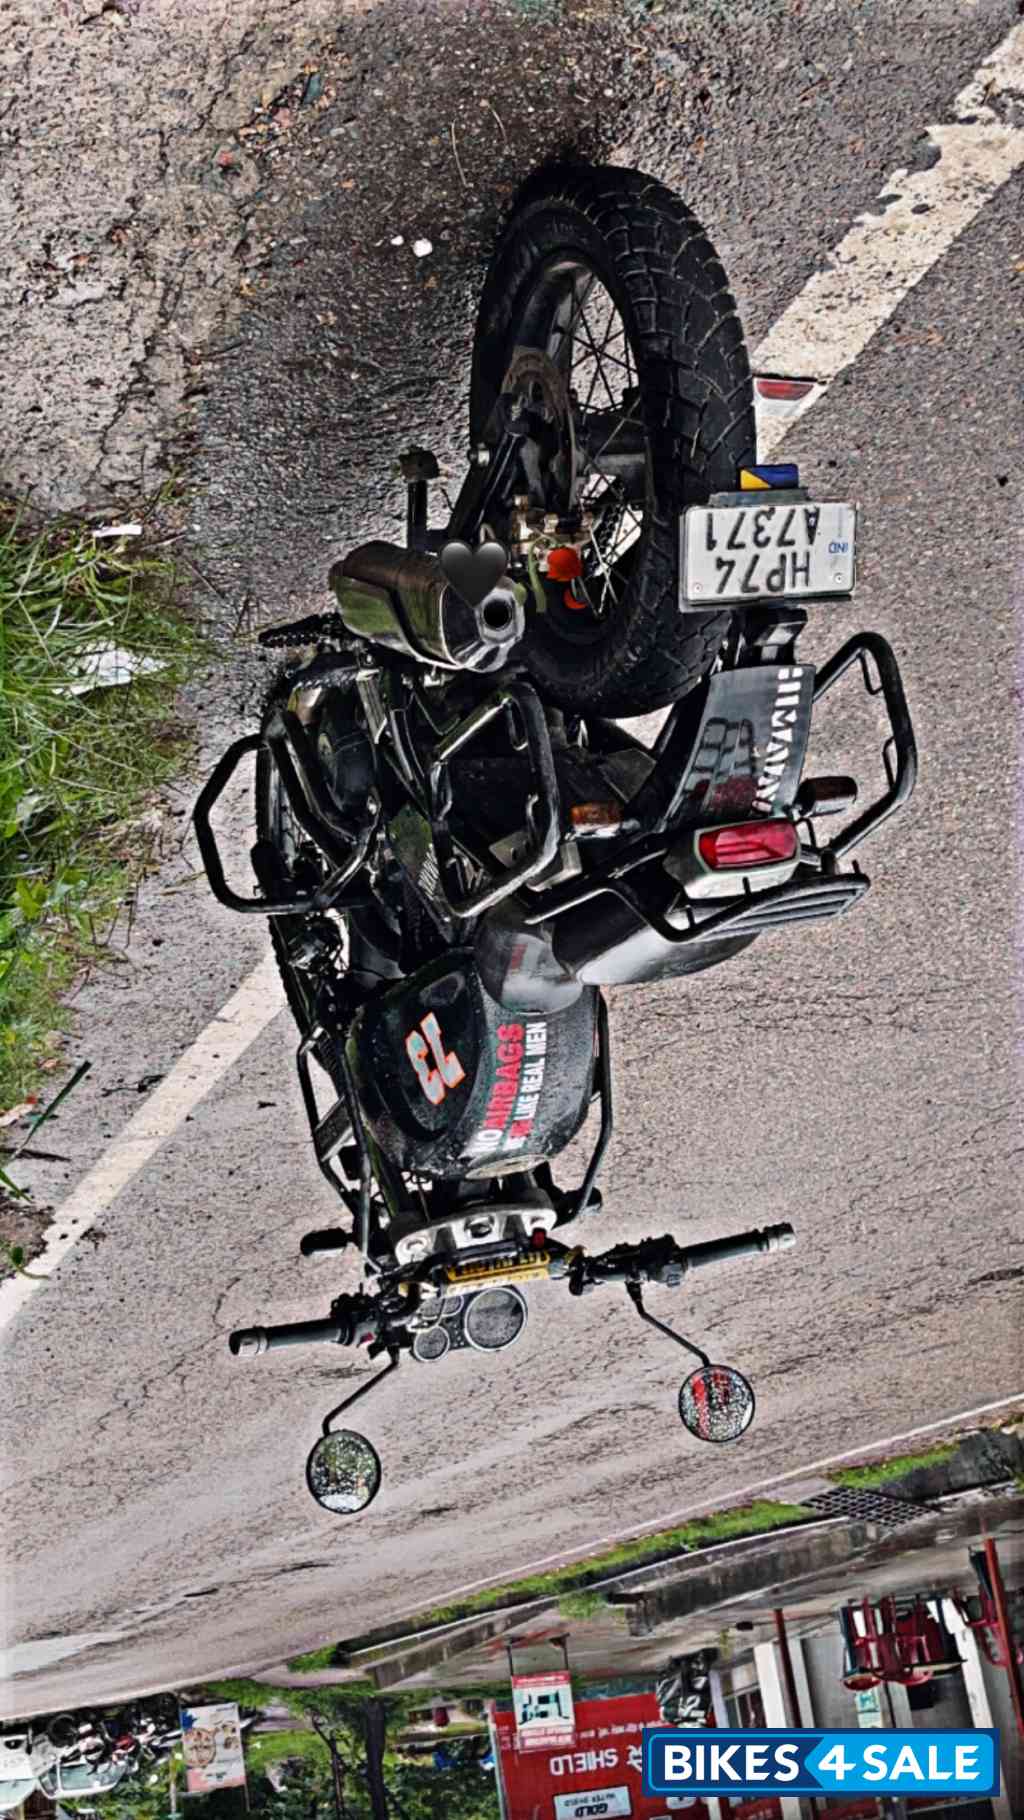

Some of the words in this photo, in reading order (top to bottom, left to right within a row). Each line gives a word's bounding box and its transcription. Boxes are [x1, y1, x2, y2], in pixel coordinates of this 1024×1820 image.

[705, 507, 820, 552] A7371
[828, 542, 849, 554] IND
[715, 551, 811, 594] HP74
[525, 1021, 547, 1056] MEN
[483, 1023, 524, 1129] AIRBAGS
[521, 1057, 546, 1093] REAL
[514, 1091, 540, 1121] LIKE
[471, 1129, 503, 1154] NO
[549, 1748, 619, 1776] SHIELD
[574, 1803, 609, 1818] GOLD
